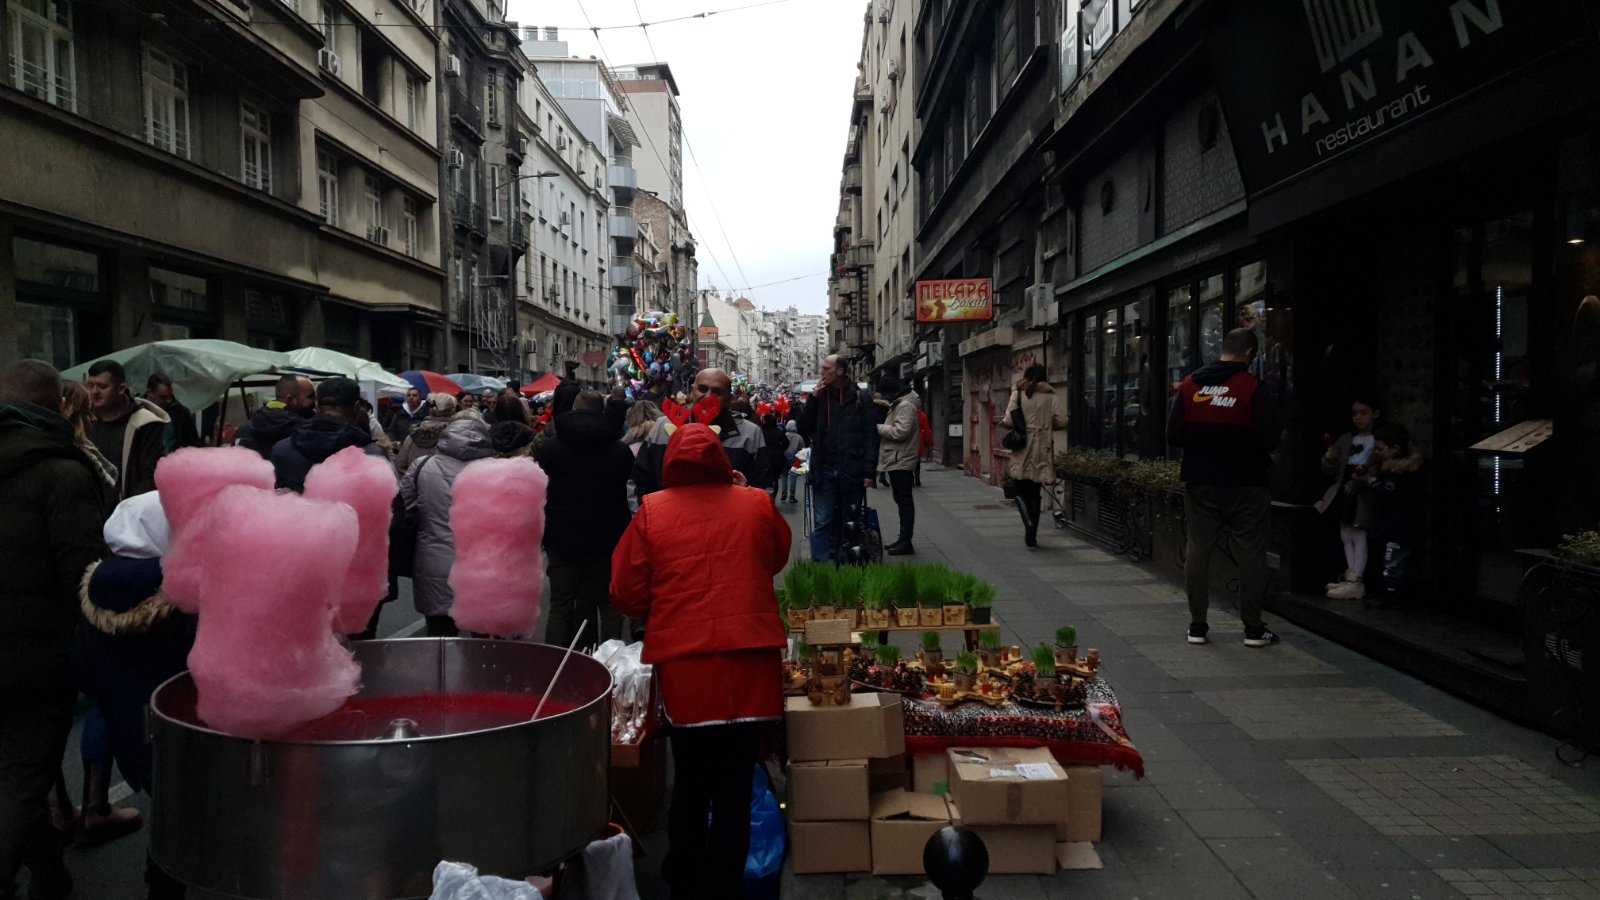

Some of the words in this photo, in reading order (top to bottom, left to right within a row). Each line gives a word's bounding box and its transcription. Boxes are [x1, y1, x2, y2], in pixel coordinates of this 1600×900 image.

[1260, 0, 1504, 154] HANAN
[1315, 83, 1432, 156] restaurant
[920, 281, 990, 301] ПЕКАРА
[1198, 385, 1230, 396] JUMP
[1210, 395, 1237, 408] MAN
